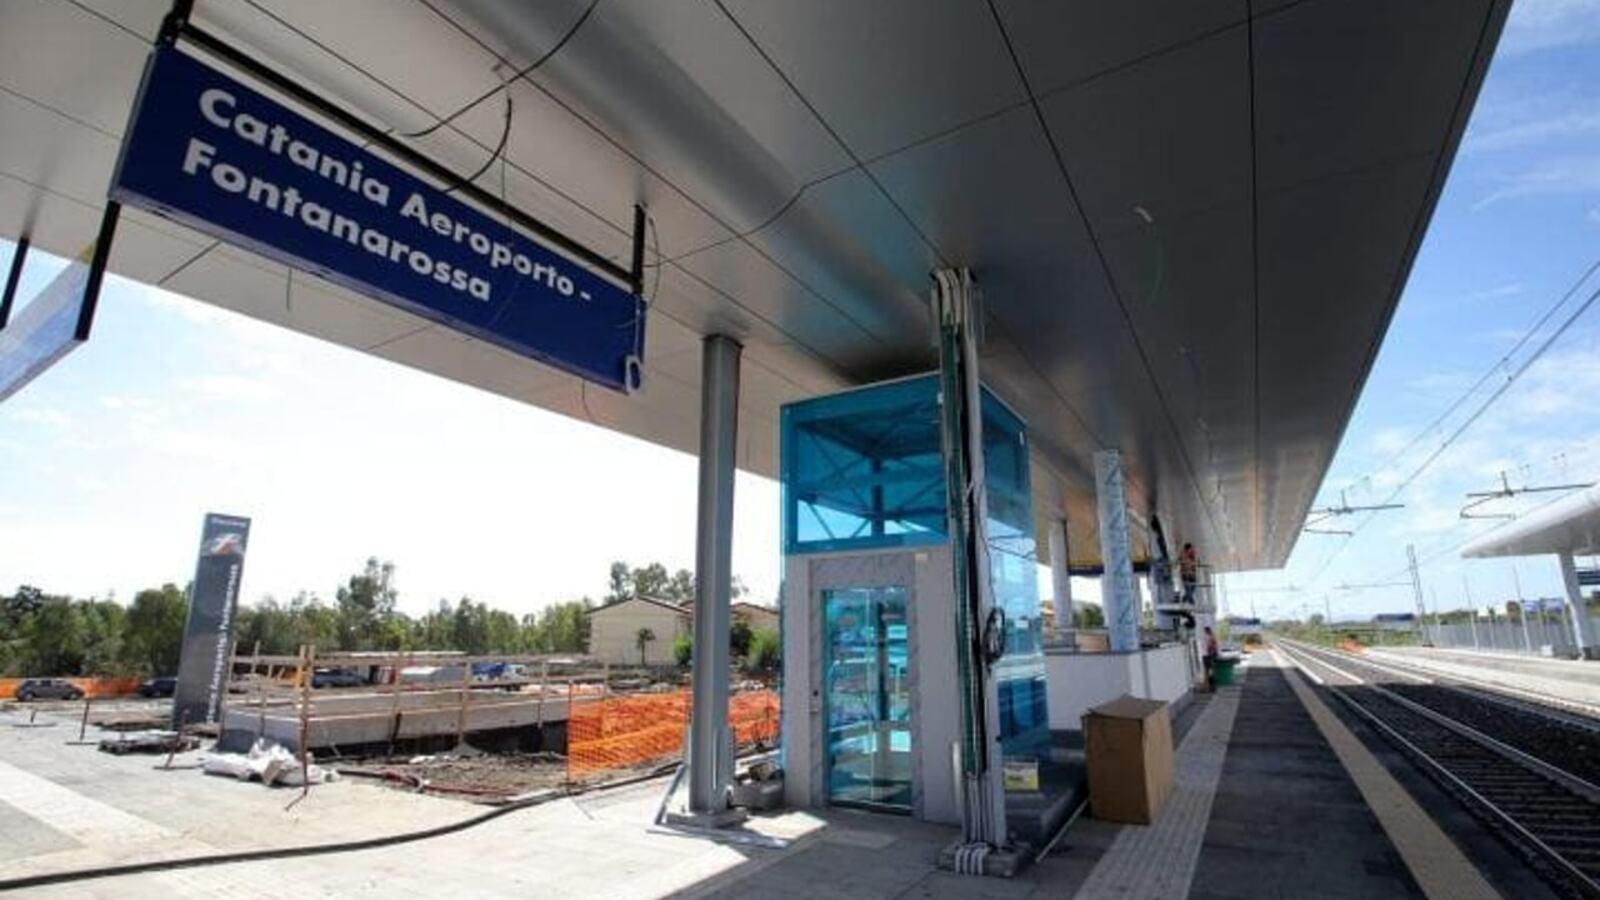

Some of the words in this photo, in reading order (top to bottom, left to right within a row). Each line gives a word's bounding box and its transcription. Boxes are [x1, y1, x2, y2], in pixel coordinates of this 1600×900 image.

[182, 138, 491, 302] Fontanarossa
[199, 88, 390, 207] Catania
[401, 193, 575, 299] Aeroporto
[581, 290, 592, 301] -
